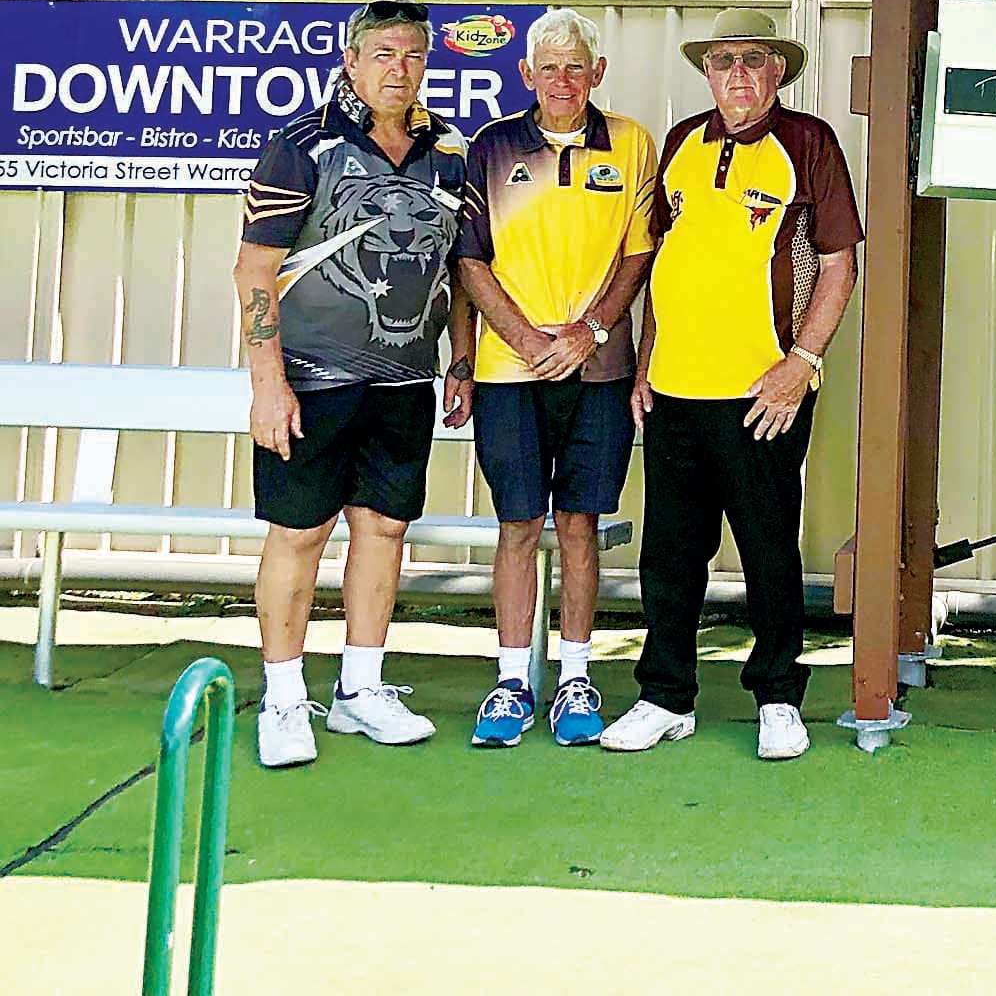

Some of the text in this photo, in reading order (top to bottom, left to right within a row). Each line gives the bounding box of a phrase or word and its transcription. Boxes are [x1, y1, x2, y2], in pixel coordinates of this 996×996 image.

[119, 18, 349, 54] WARRAGU
[456, 30, 506, 46] KidZone
[13, 63, 504, 119] DOWNTOWER
[17, 125, 123, 149] Sportsbar
[140, 127, 198, 149] Bistro
[217, 128, 262, 150] Kids
[25, 160, 109, 180] Victoria
[115, 161, 181, 181] Street
[187, 163, 256, 182] Warra
